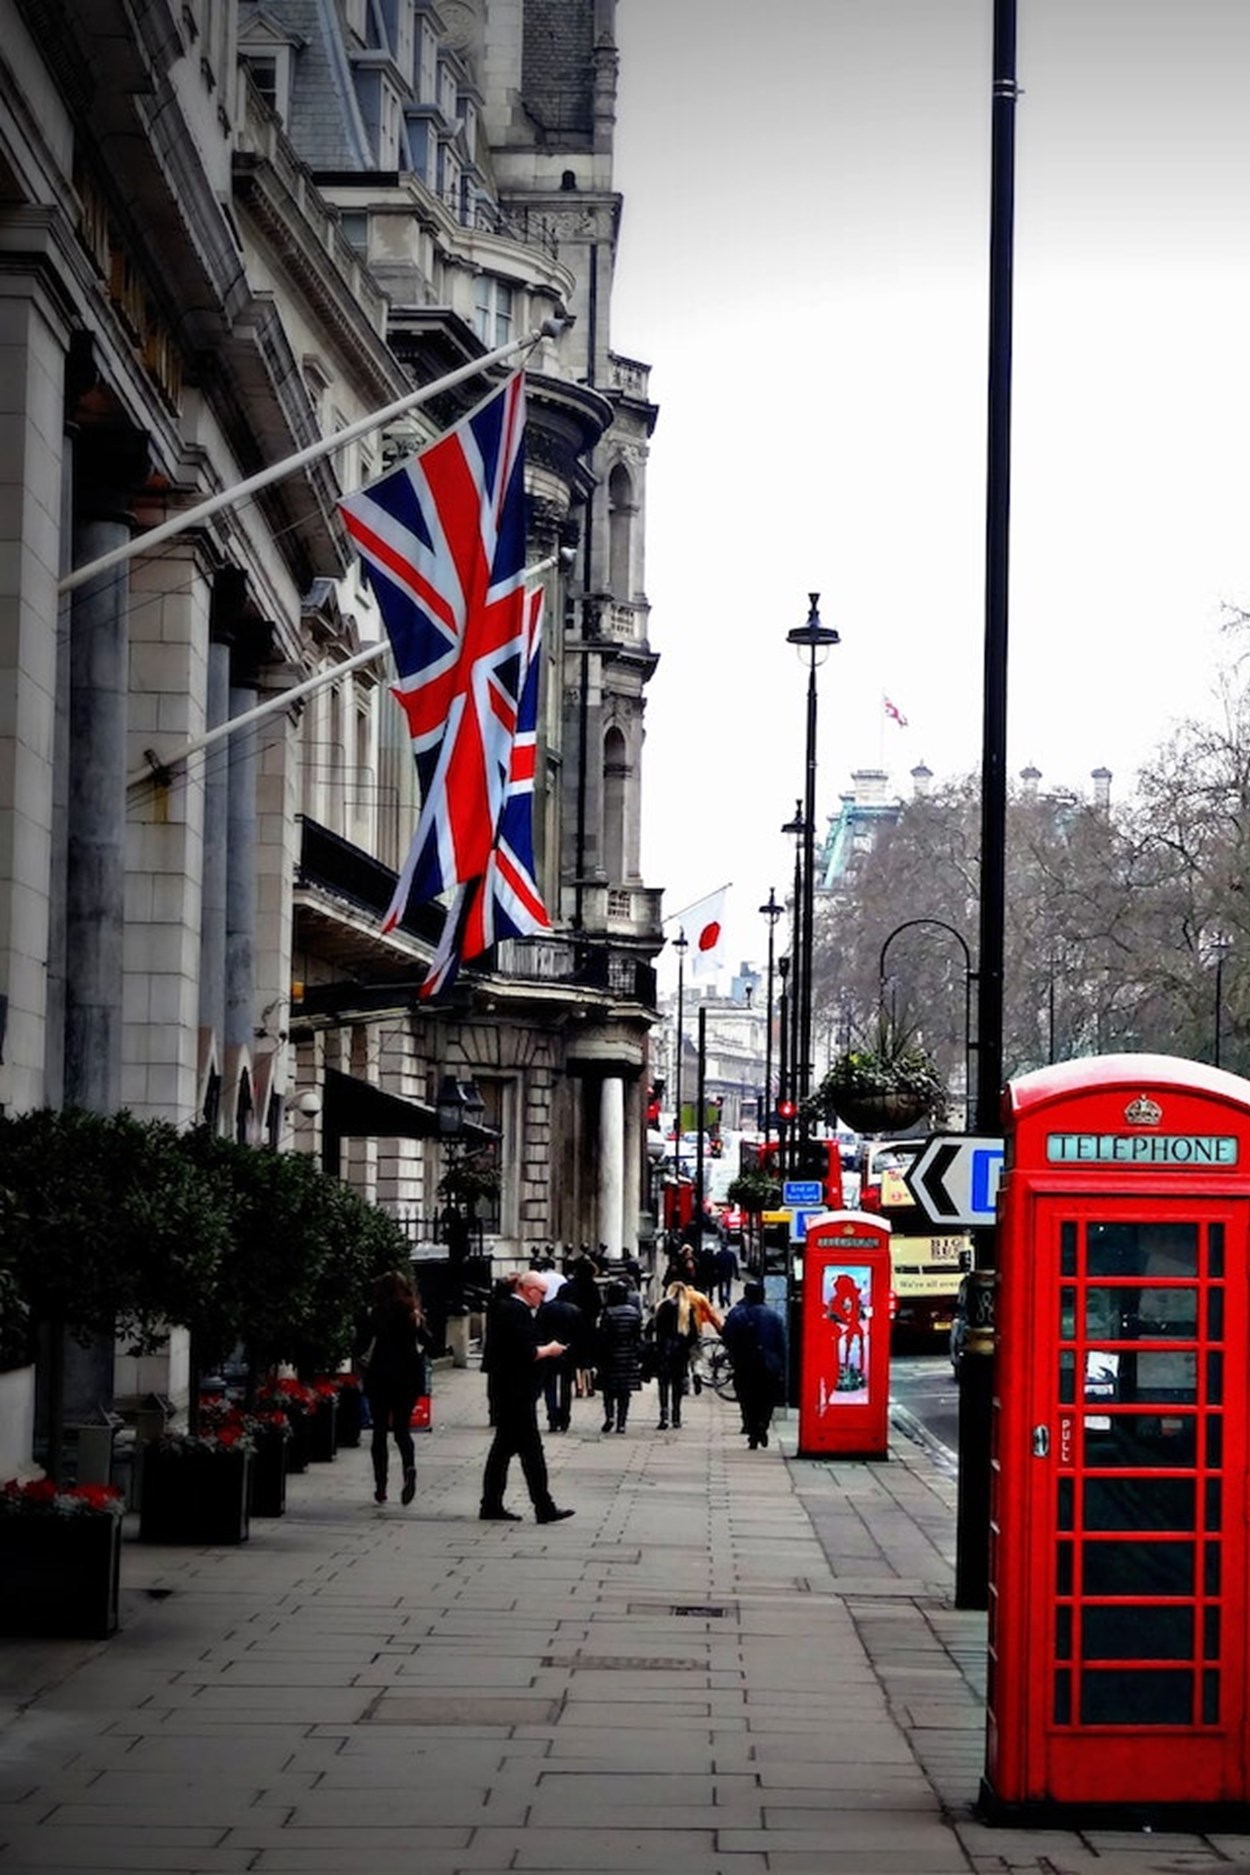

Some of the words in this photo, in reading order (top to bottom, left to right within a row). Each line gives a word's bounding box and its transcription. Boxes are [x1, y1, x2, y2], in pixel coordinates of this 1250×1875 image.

[1052, 1134, 1231, 1162] TELEPHONE
[931, 1239, 963, 1248] BIG
[1062, 1419, 1071, 1462] PULL
